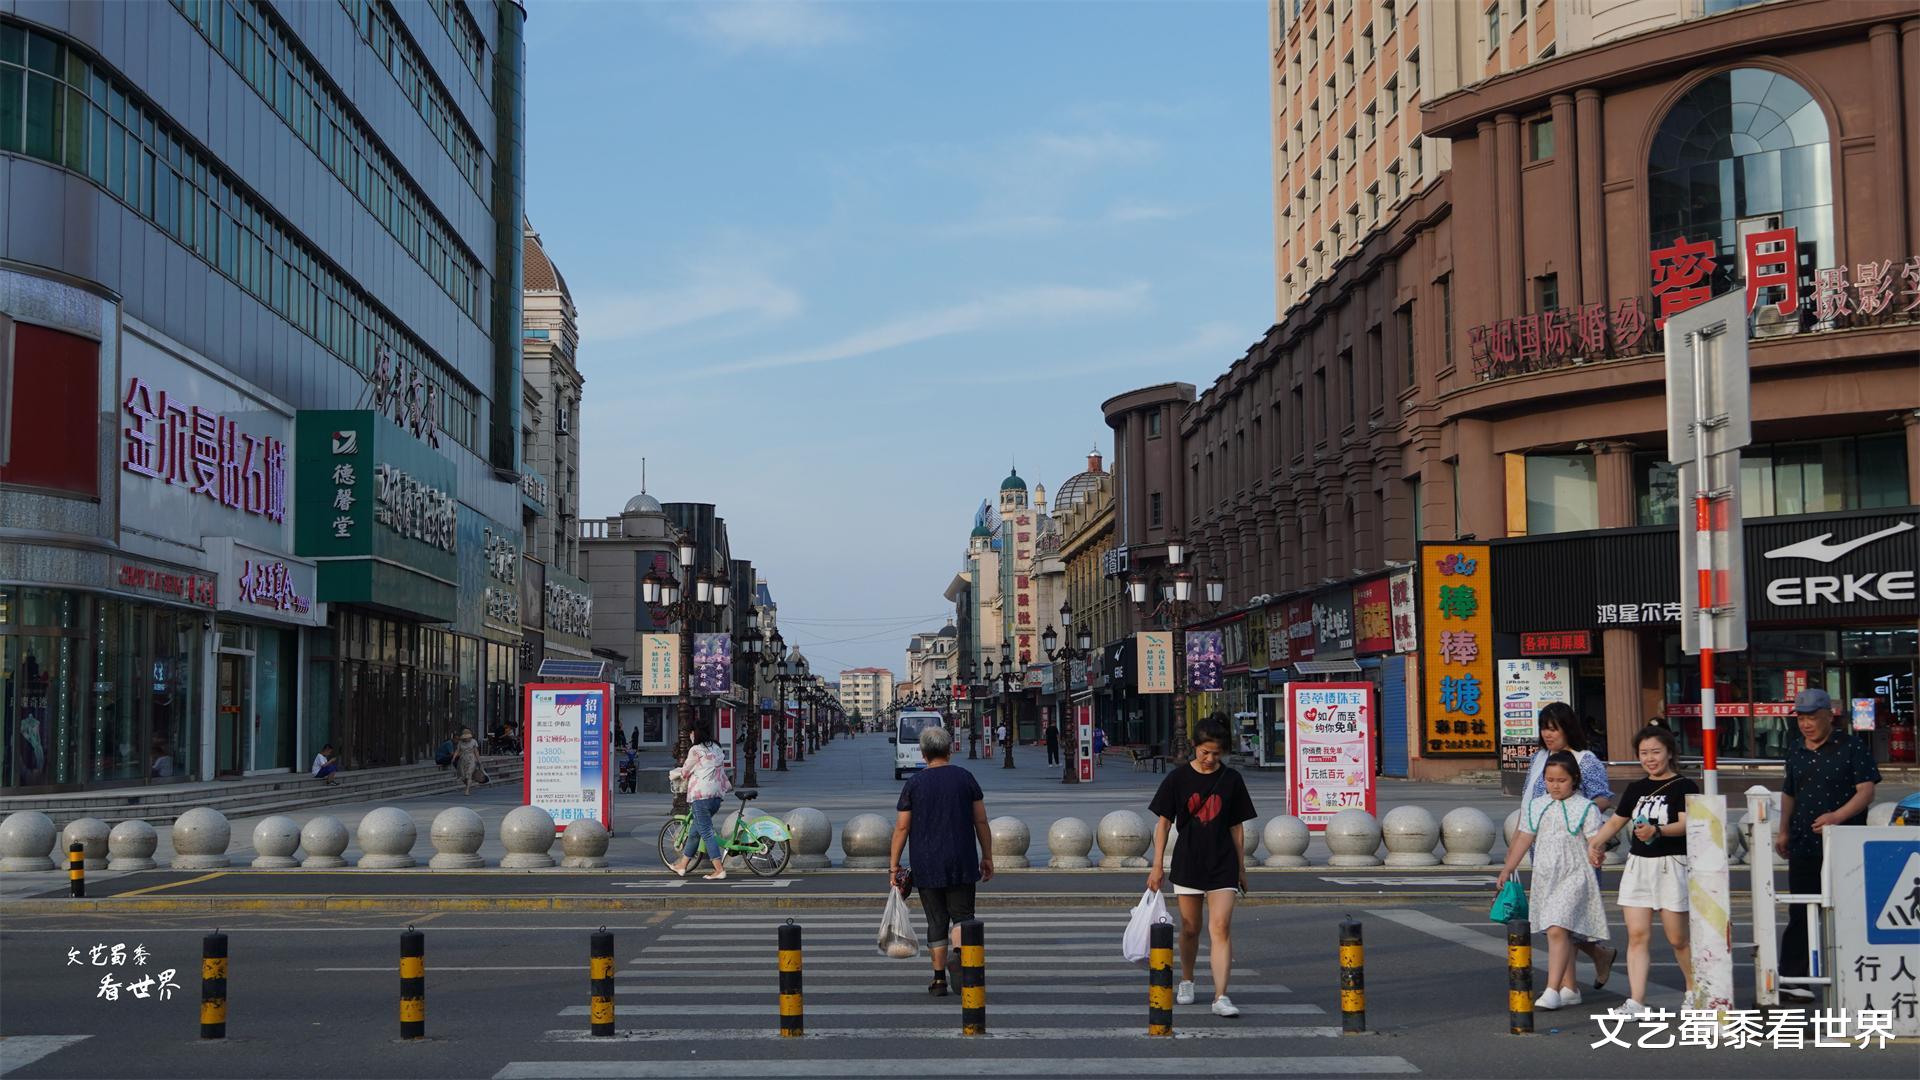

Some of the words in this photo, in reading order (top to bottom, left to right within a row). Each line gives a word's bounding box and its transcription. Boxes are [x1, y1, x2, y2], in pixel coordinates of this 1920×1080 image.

[1650, 225, 1799, 332] 蜜月
[124, 377, 288, 524] 金尔曼钻石城
[332, 464, 357, 538] 德馨堂
[1766, 571, 1915, 606] ERKE
[1597, 602, 1682, 624] 鸿星尔克
[1439, 584, 1481, 717] 棒棒糖
[1507, 661, 1560, 671] 手机维修
[585, 698, 598, 725] 招聘
[1684, 706, 1745, 714] 鸿星工厂店
[1854, 955, 1916, 982] 行人
